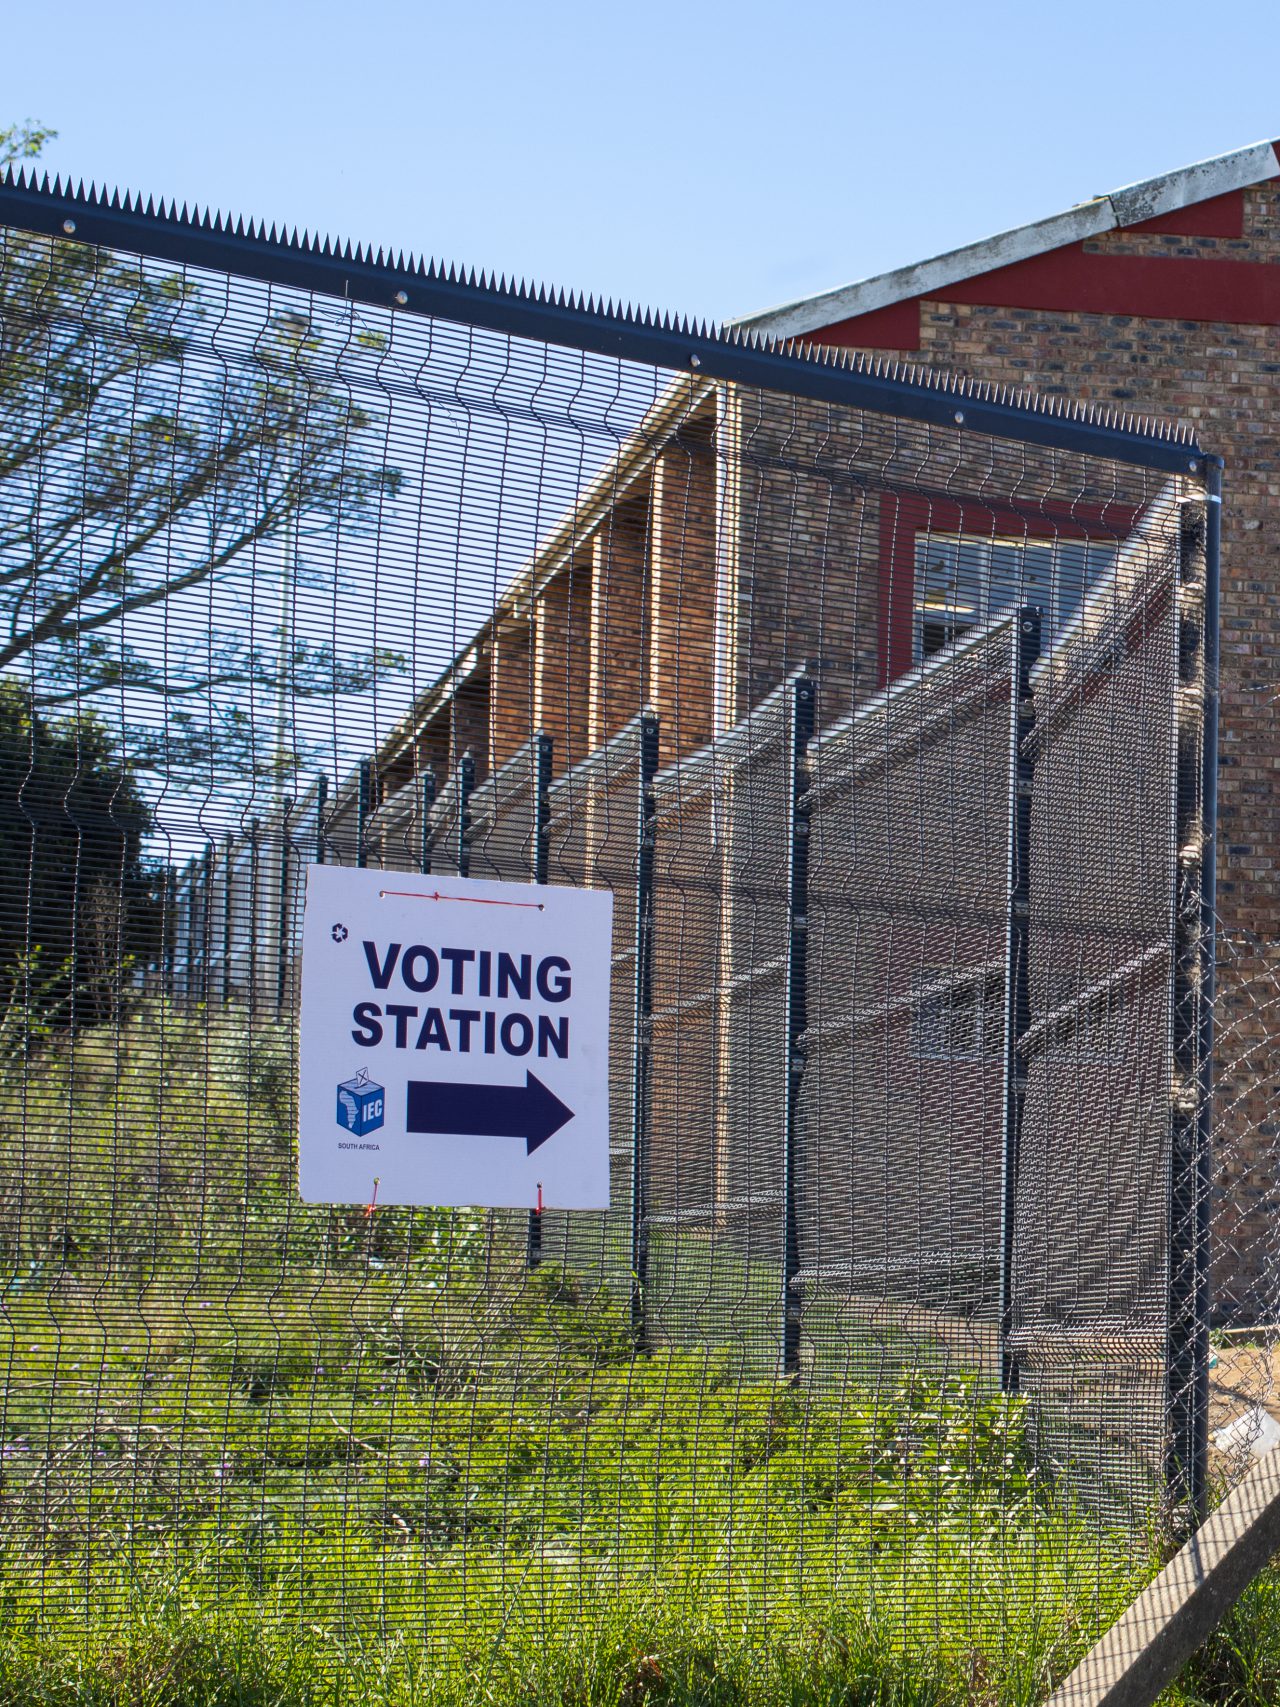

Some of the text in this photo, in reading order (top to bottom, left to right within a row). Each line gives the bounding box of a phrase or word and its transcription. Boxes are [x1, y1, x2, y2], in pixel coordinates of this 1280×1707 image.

[362, 941, 572, 1003] VOTING
[351, 1002, 569, 1059] STATION
[363, 1099, 382, 1122] IEC
